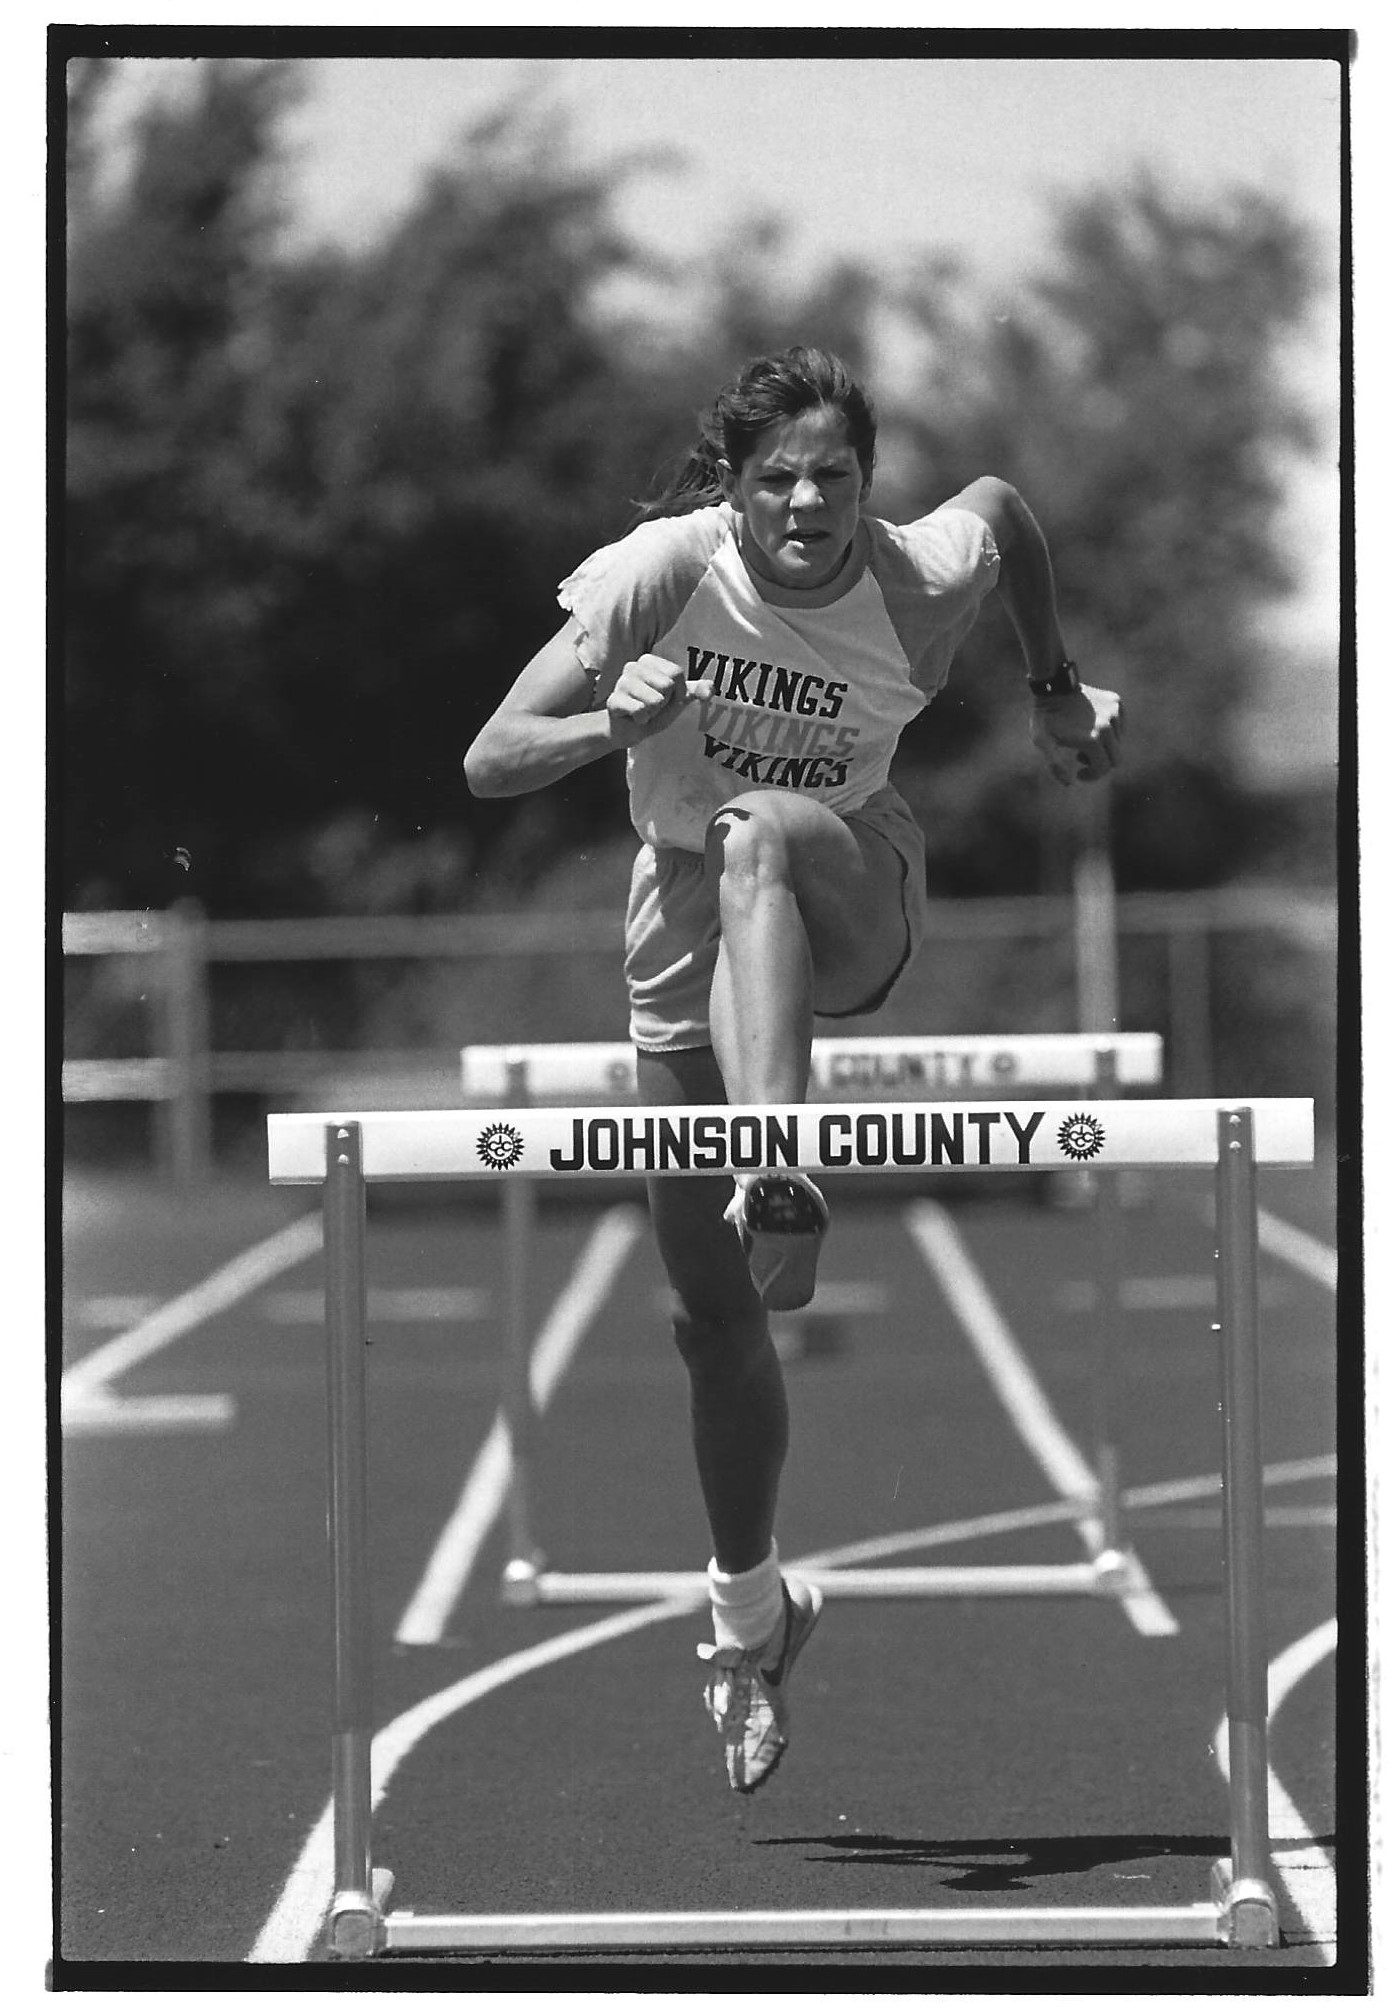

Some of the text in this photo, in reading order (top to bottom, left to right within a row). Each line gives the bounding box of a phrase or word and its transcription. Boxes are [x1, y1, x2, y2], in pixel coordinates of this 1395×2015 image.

[687, 646, 848, 719] VIKINGS
[699, 700, 860, 757] VIKINGS
[704, 733, 854, 788] VIKINGS
[550, 1112, 1046, 1171] JOHNSON COUNTY
